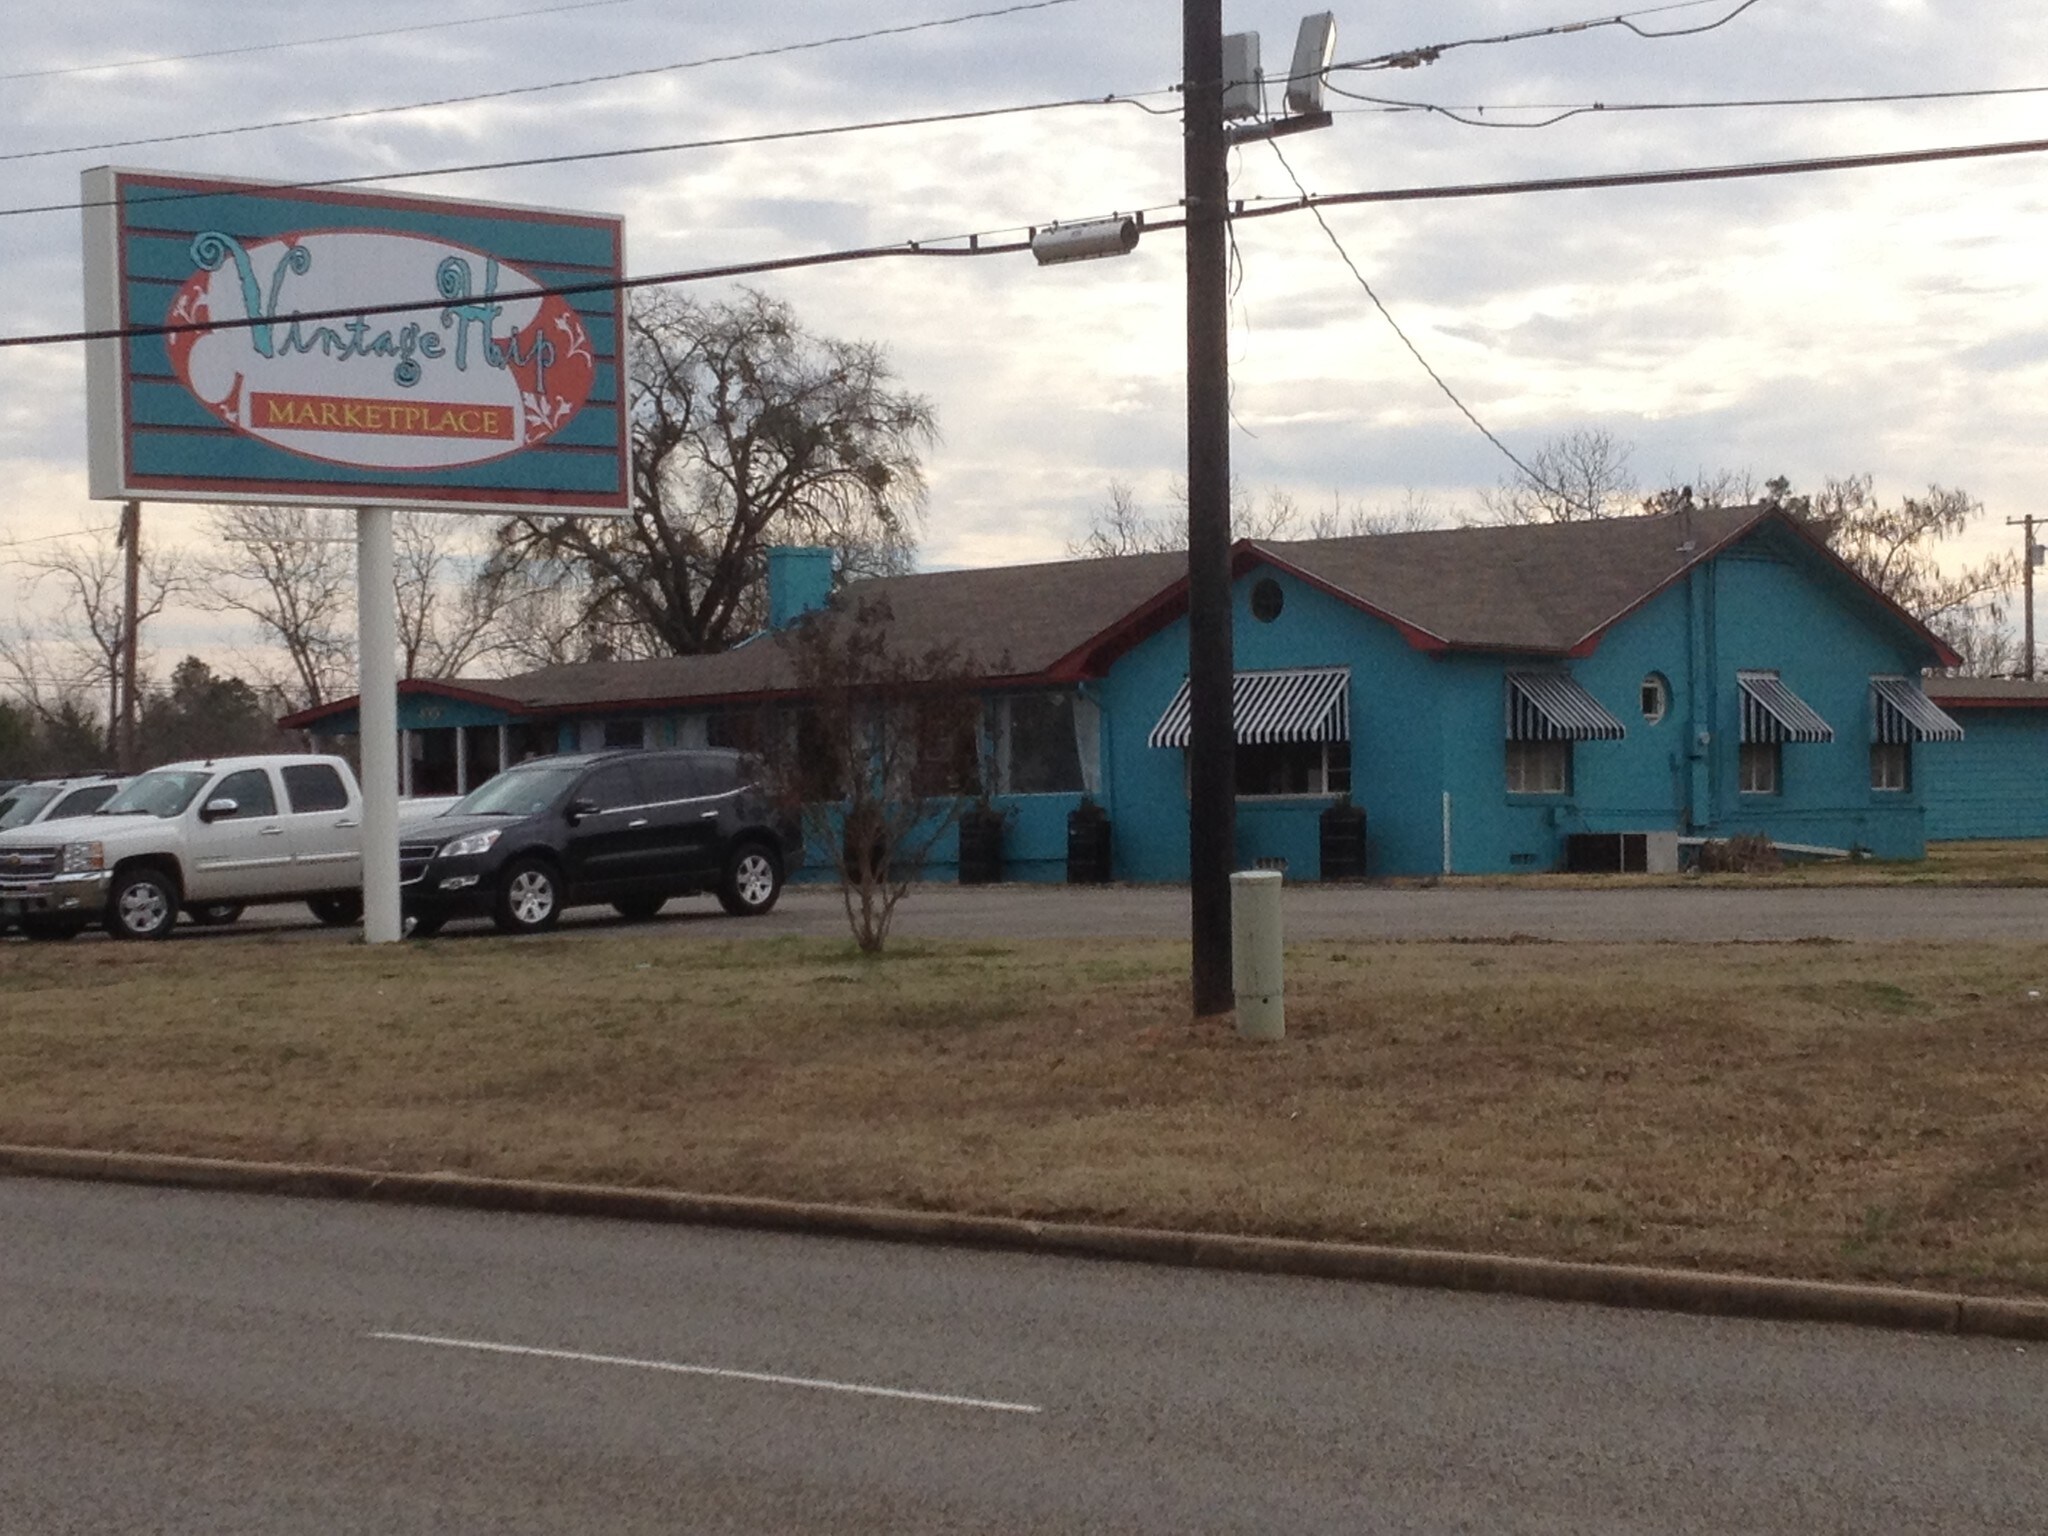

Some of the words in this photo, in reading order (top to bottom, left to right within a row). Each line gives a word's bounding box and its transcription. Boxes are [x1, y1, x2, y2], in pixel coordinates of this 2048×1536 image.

[190, 231, 446, 388] Vintage
[436, 255, 555, 394] Hip
[267, 399, 500, 435] MARKETPLACE
